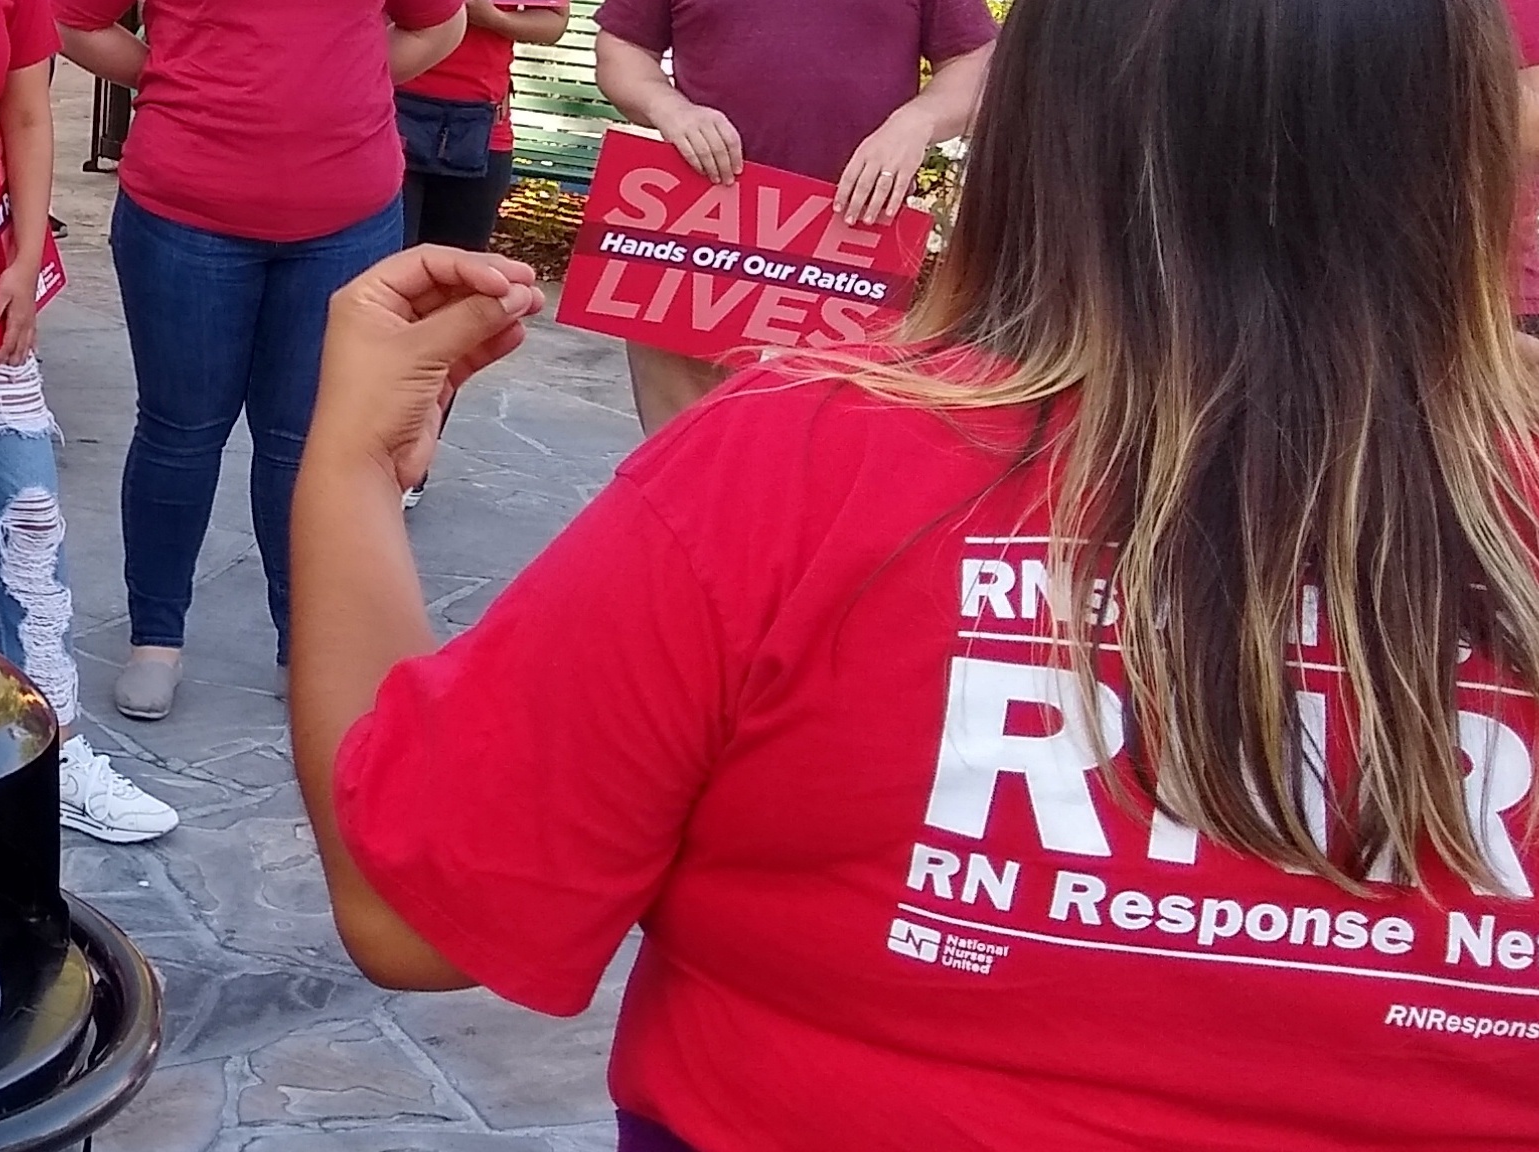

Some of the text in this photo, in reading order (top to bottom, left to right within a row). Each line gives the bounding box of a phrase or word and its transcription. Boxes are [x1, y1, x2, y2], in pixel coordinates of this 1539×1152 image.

[602, 166, 895, 269] SAVE
[600, 231, 888, 300] Hands Off Our Ratios
[584, 258, 879, 348] LIVES
[906, 842, 1539, 971] RN Response Ne
[941, 952, 992, 976] United
[942, 943, 995, 966] Nurses
[945, 933, 1010, 958] National
[1384, 1003, 1539, 1040] RNRespons
